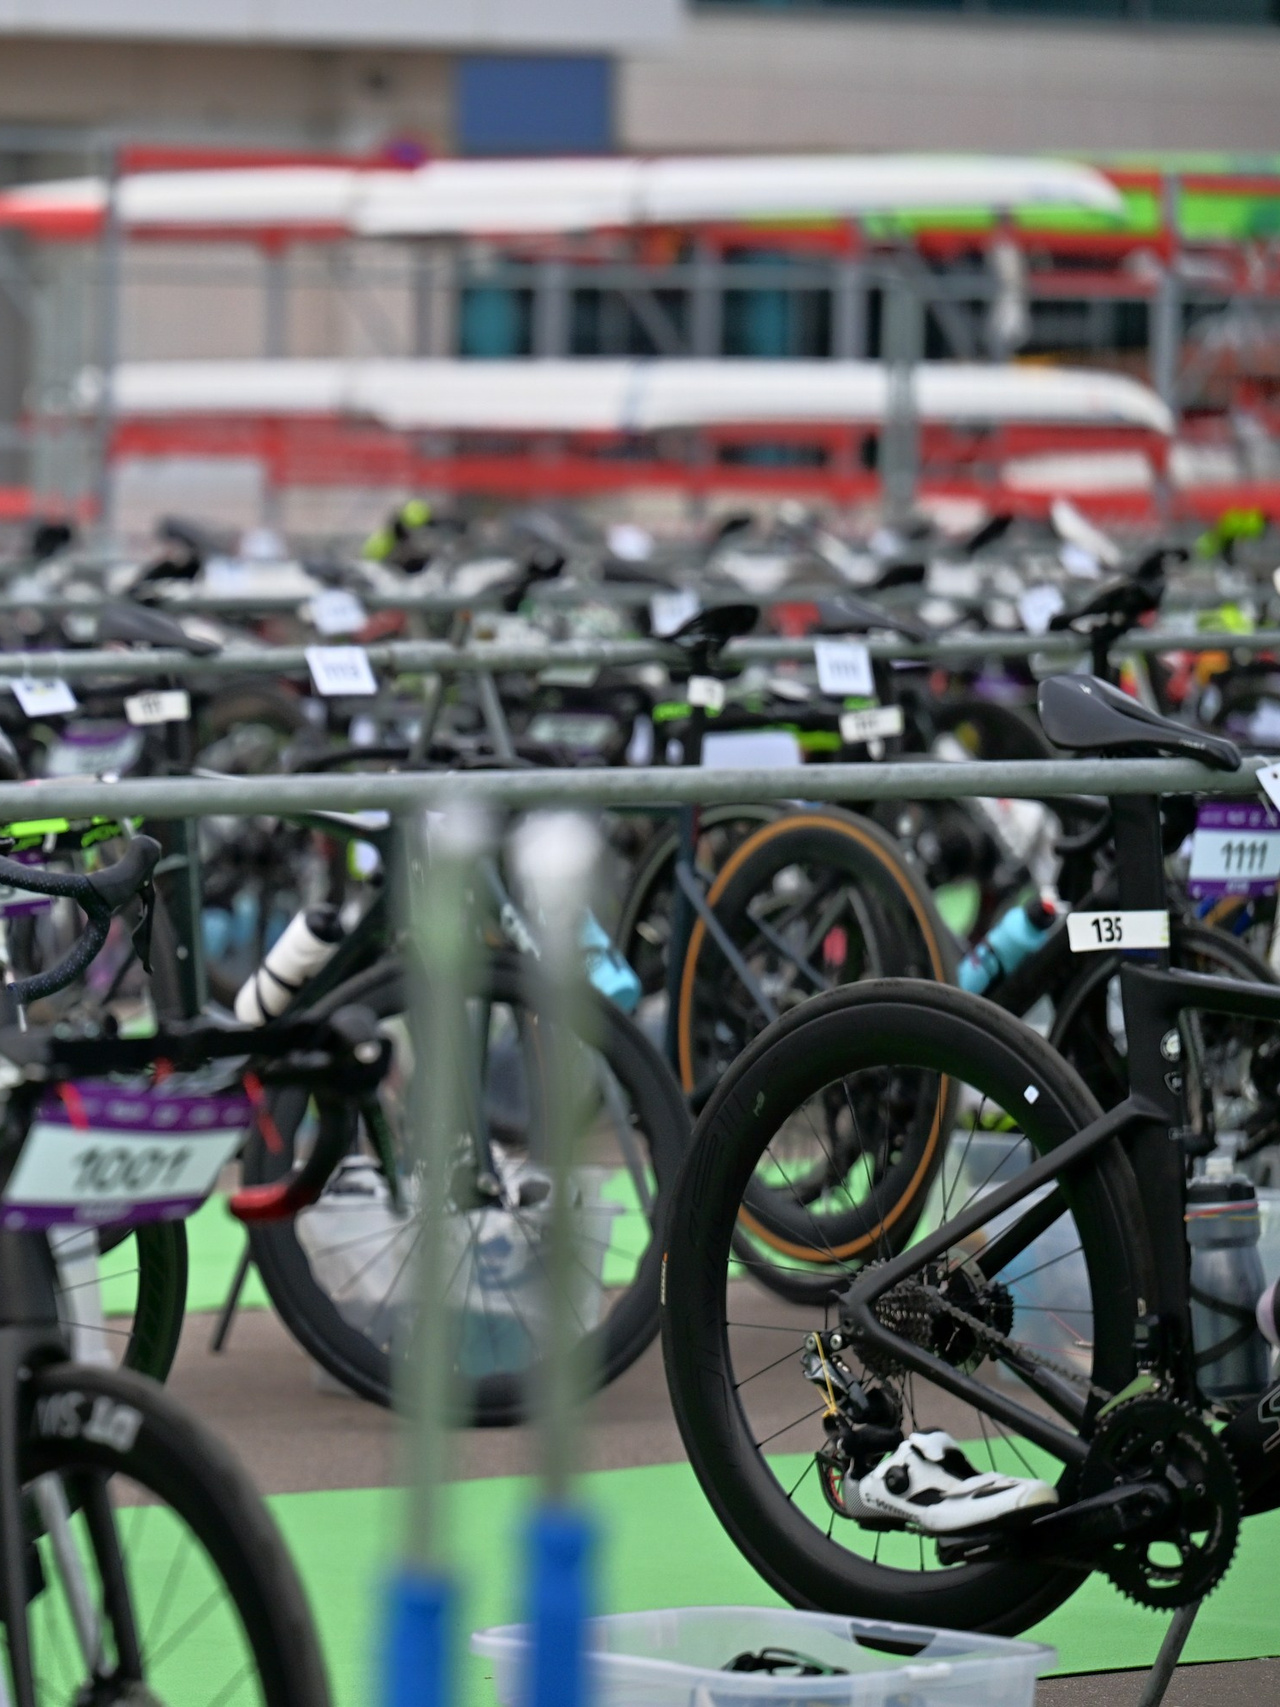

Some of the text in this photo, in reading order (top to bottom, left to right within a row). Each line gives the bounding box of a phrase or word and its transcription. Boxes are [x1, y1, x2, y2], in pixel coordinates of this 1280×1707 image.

[1222, 841, 1267, 870] 1111
[1091, 917, 1123, 943] 135
[75, 1145, 195, 1192] 1001
